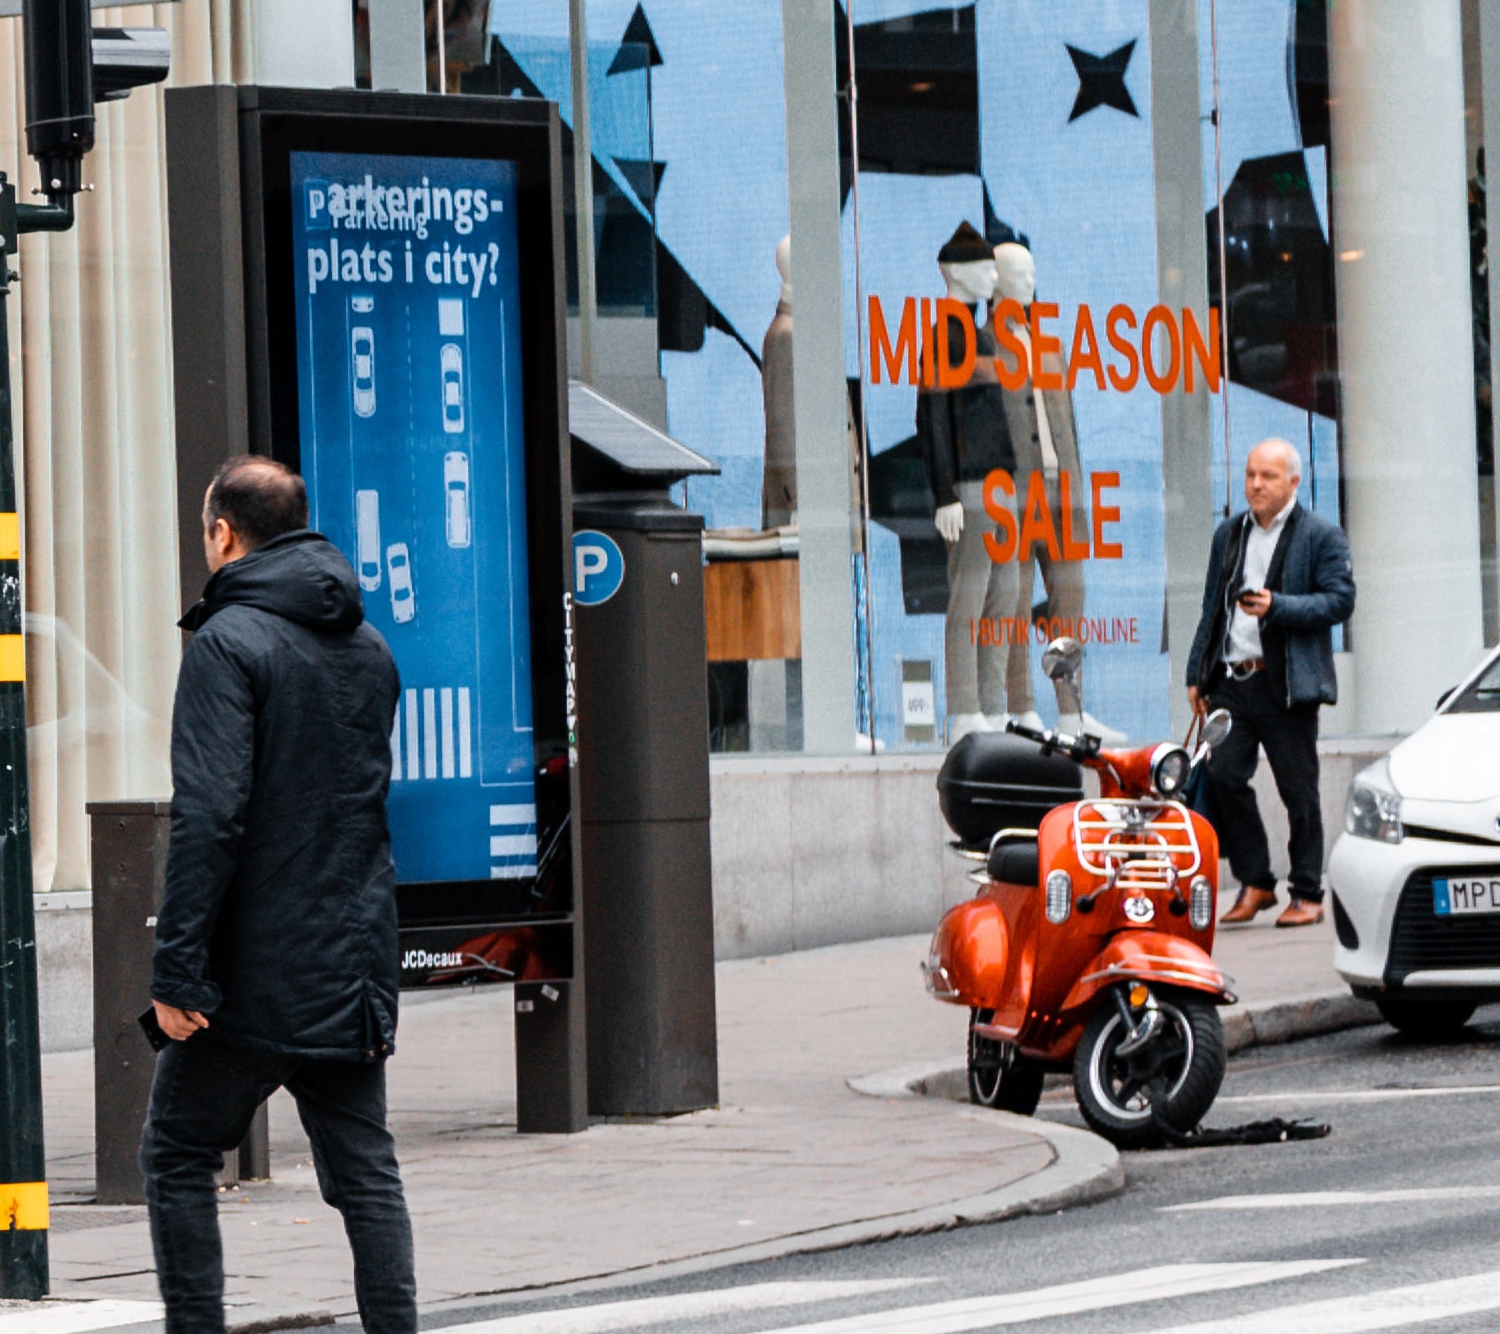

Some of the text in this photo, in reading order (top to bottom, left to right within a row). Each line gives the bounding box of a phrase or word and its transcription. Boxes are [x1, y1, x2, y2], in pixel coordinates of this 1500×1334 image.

[307, 237, 500, 298] plats i city?
[868, 294, 1220, 394] MID SEASON
[982, 468, 1123, 564] SALE
[575, 546, 608, 593] P
[969, 615, 1140, 647] I BUTIK OCH ONLINE
[401, 949, 463, 969] JCDecaux
